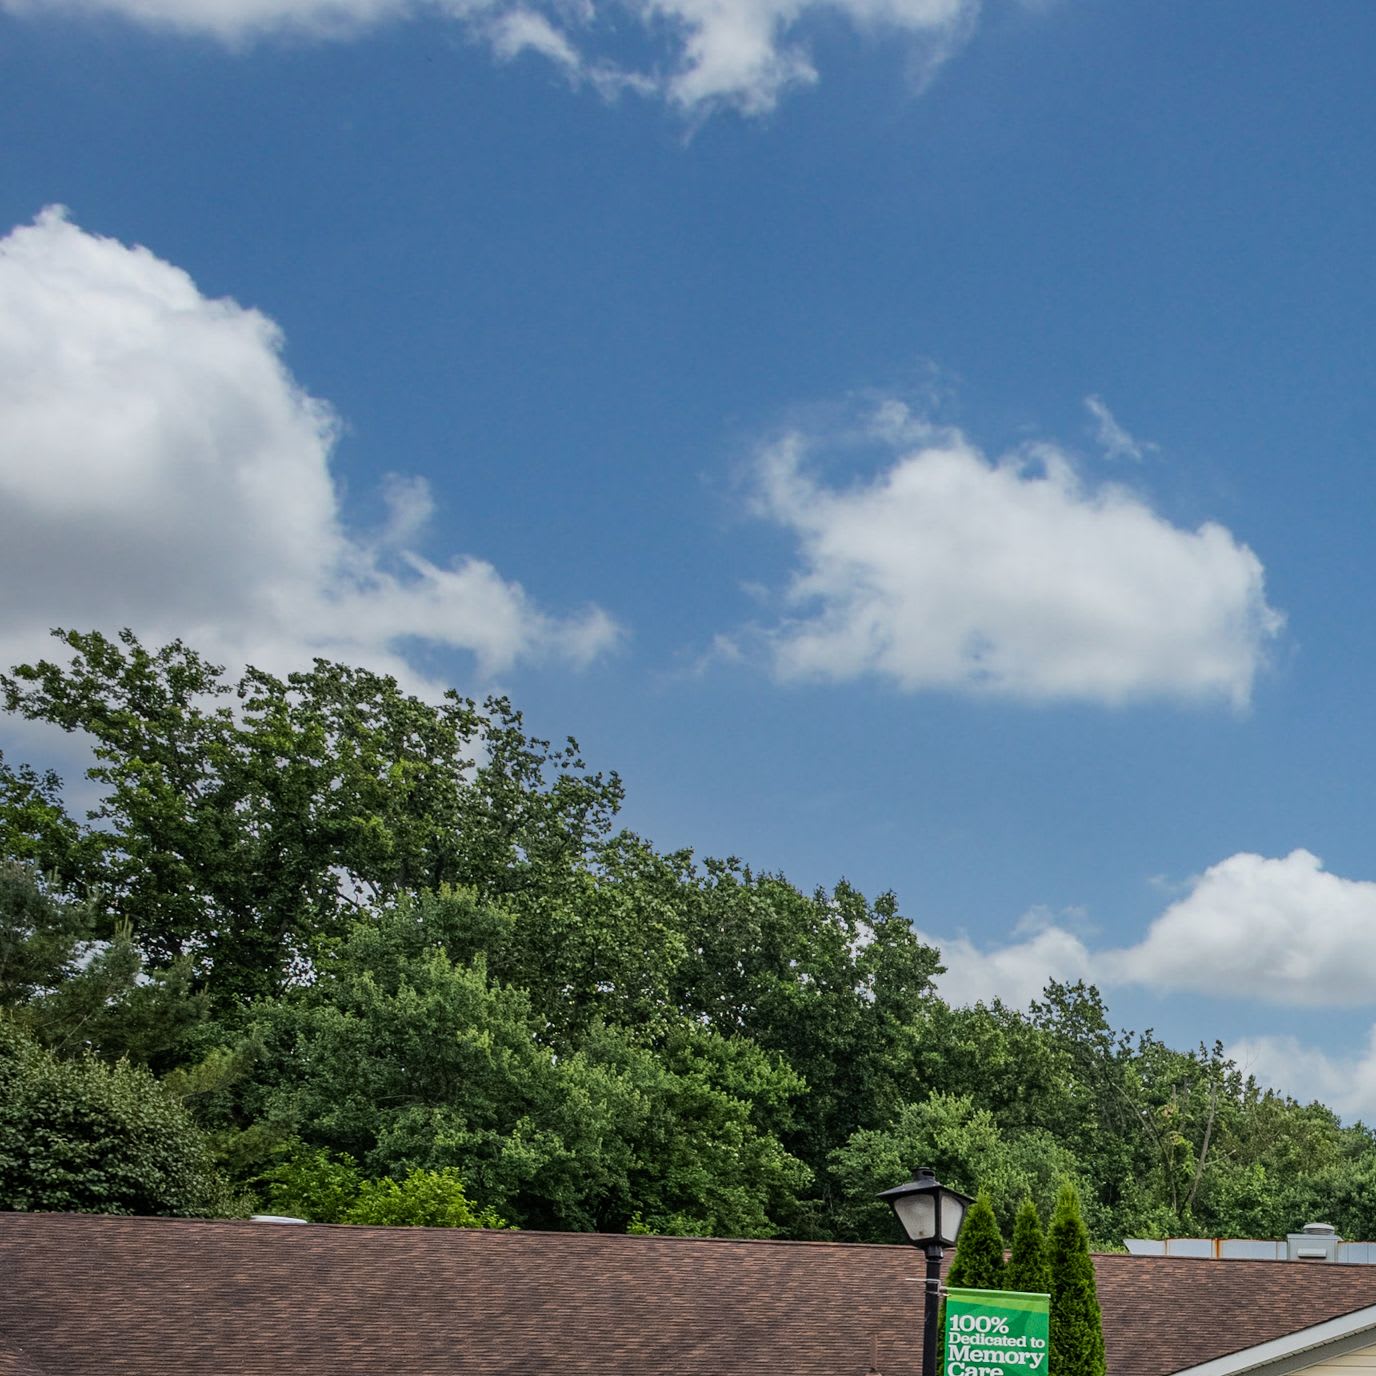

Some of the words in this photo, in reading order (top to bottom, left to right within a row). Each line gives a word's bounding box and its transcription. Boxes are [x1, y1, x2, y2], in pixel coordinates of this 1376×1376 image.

[949, 1314, 1009, 1334] 100%
[948, 1331, 1027, 1348] Dedicated
[1030, 1336, 1046, 1349] to
[947, 1344, 1046, 1369] Memory
